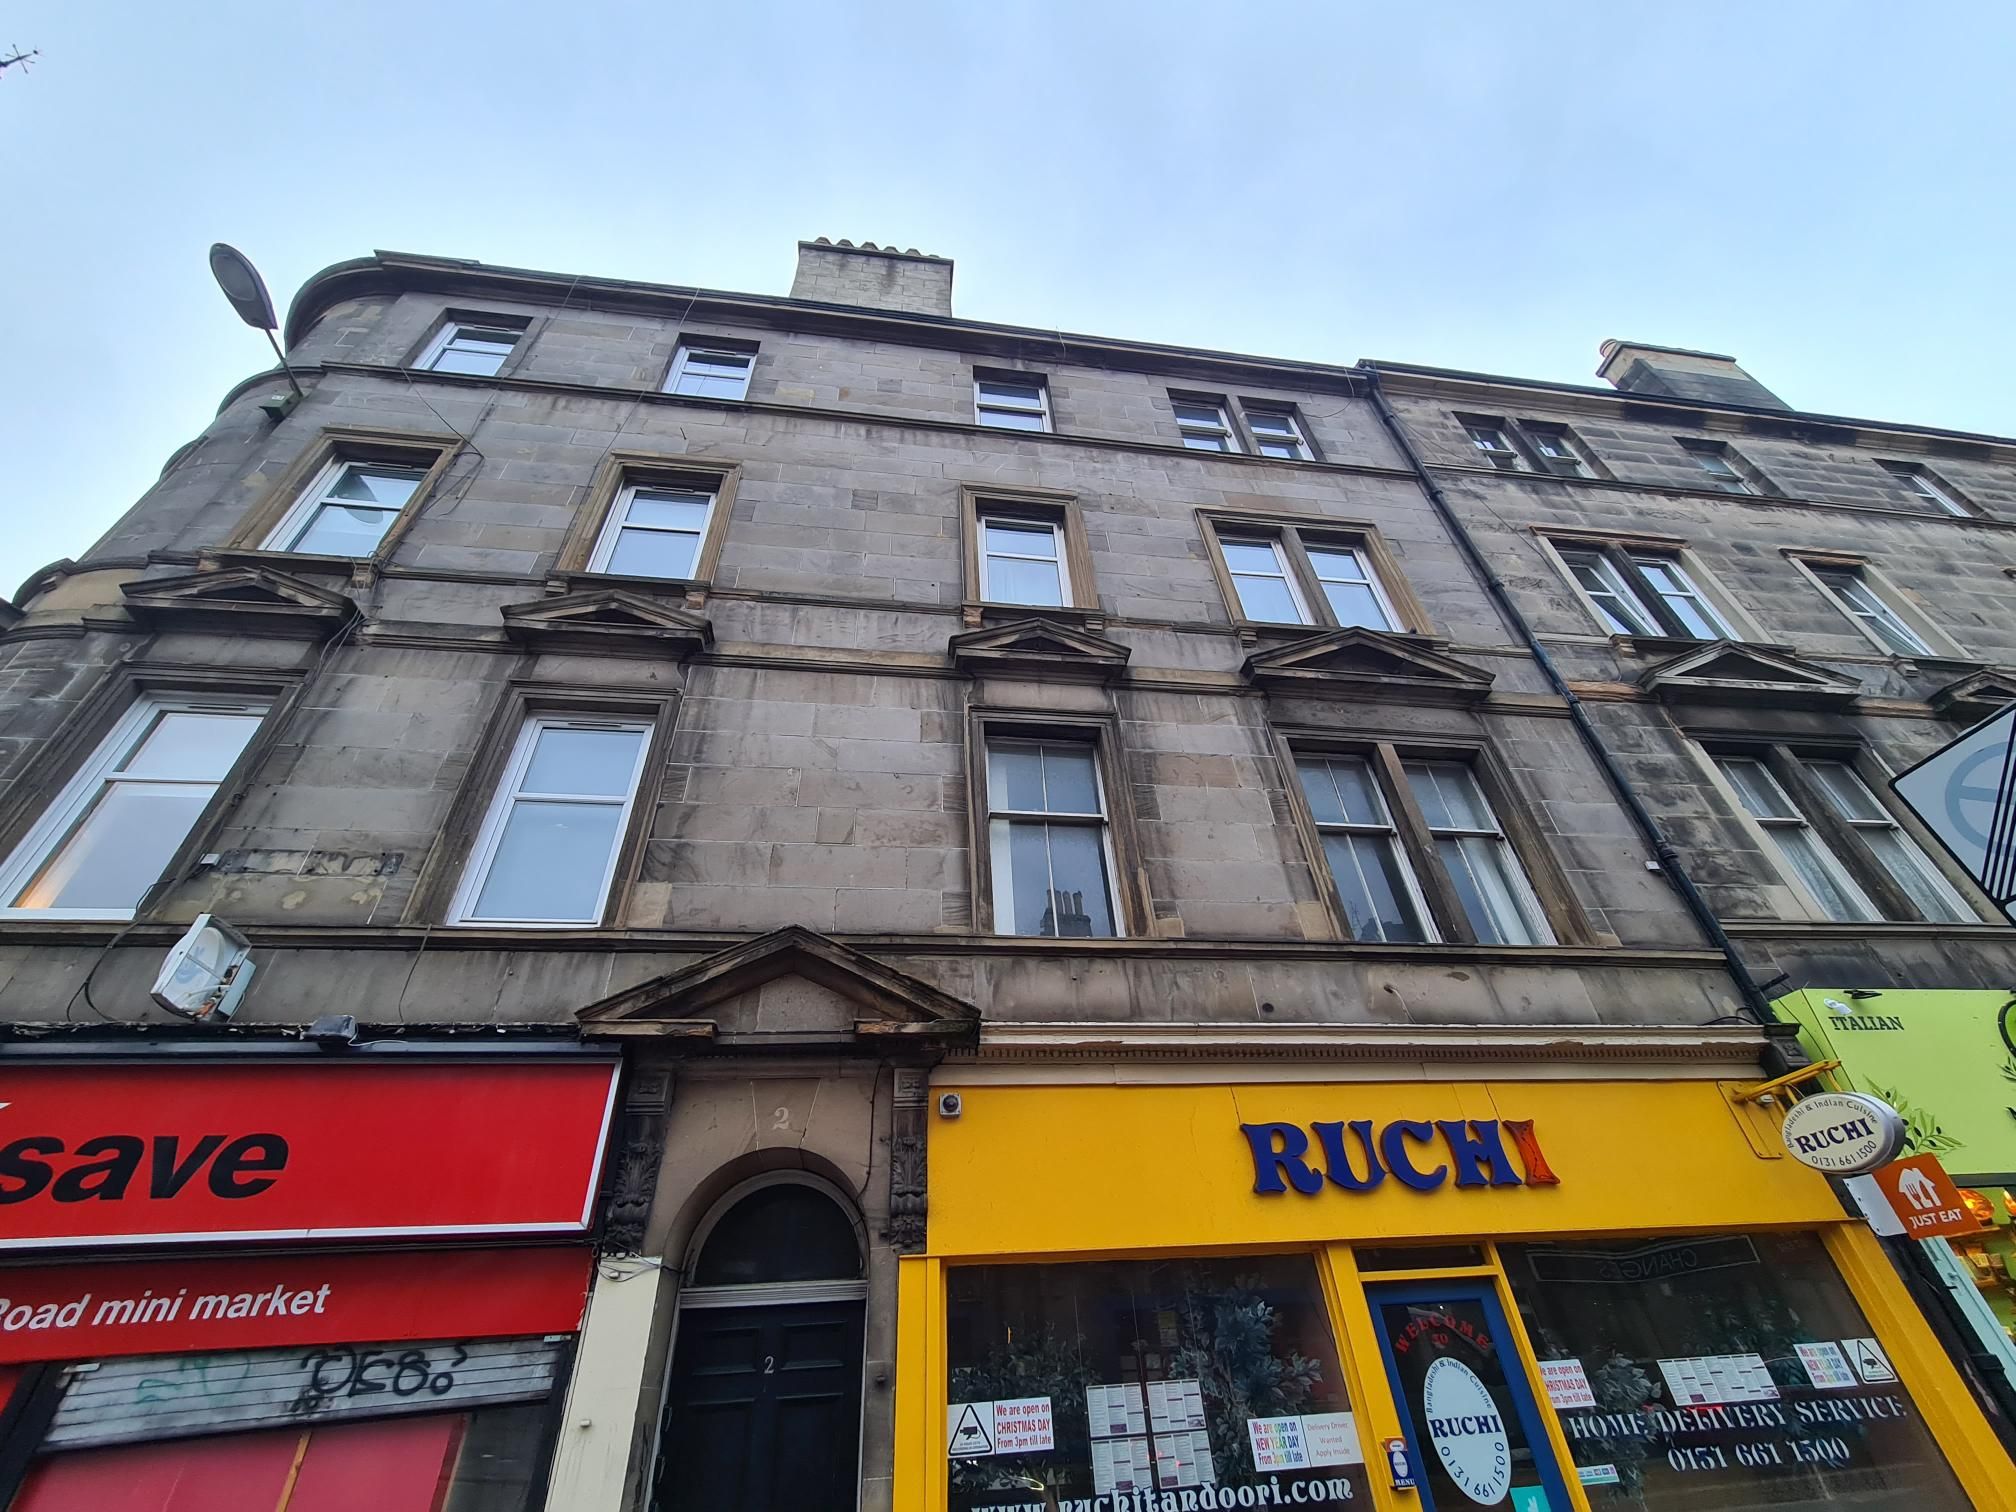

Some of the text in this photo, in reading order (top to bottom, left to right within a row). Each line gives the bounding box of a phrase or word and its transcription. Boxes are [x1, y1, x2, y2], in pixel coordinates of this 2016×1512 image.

[1828, 1016, 1904, 1031] ITALIAN
[772, 1107, 789, 1130] 2
[1814, 1099, 1844, 1109] Indian
[1846, 1100, 1878, 1125] Cuisine
[1794, 1118, 1875, 1154] RUCHI
[1239, 1119, 1560, 1196] RUCHI
[1812, 1140, 1877, 1167] 0131 661 1500
[0, 1133, 289, 1205] save
[1909, 1208, 1962, 1230] JUST EAT
[91, 1288, 187, 1326] mini
[189, 1284, 330, 1320] market
[1395, 1315, 1489, 1353] WELCOME
[764, 1356, 774, 1374] 2
[1447, 1359, 1468, 1376] Indian
[1470, 1375, 1492, 1409] Cuisine
[1545, 1379, 1576, 1392] HRISTMAS
[996, 1403, 1050, 1418] We are open on
[1567, 1395, 1908, 1440] HOME DELIVERY SERVICE
[996, 1418, 1051, 1435] CHRISTMAS DAY
[1252, 1422, 1298, 1437] We are open on
[1429, 1414, 1502, 1438] RUCHI
[997, 1437, 1014, 1449] From
[1015, 1436, 1028, 1448] 3pm
[1029, 1436, 1038, 1446] till
[1040, 1434, 1052, 1445] late
[1255, 1435, 1300, 1451] NEW YEAR DAY
[1735, 1441, 1782, 1467] 661
[1785, 1437, 1851, 1463] 1500
[1258, 1453, 1273, 1465] From
[1284, 1451, 1292, 1464] till
[1292, 1450, 1304, 1463] late
[1441, 1446, 1470, 1487] 0131
[971, 1475, 1352, 1512] ruchitandoori.com
